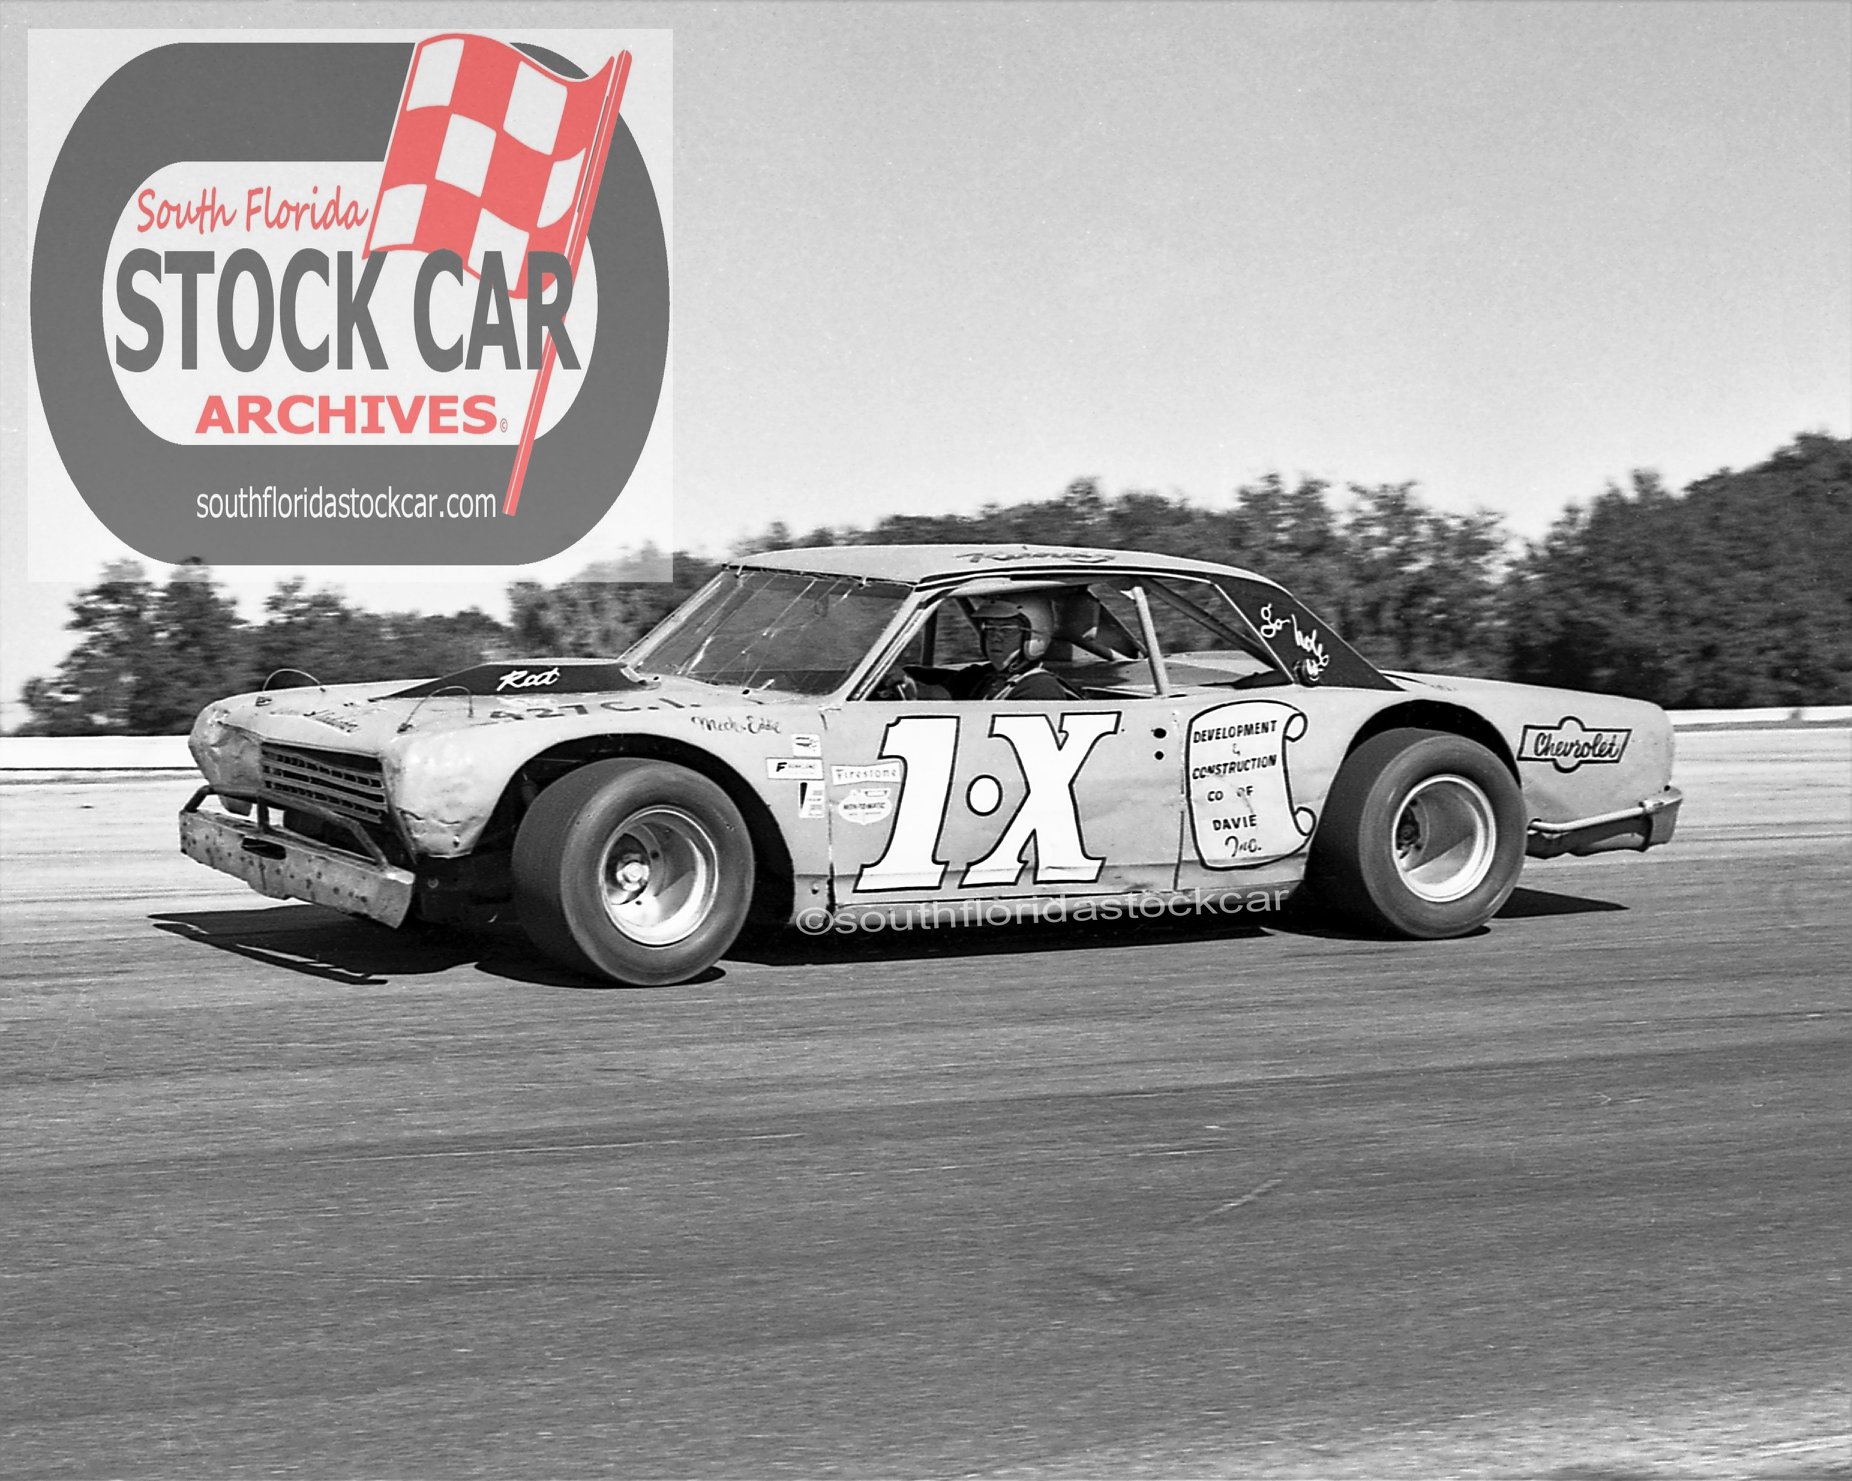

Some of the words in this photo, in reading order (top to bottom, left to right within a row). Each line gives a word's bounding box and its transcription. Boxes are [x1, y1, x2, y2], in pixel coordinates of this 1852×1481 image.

[1193, 720, 1278, 743] DEVELOPMENT
[1534, 732, 1620, 759] Chevrolet
[835, 768, 897, 780] Firestone
[1192, 754, 1278, 780] CONSTRUCTION
[1212, 814, 1258, 831] DAVIE
